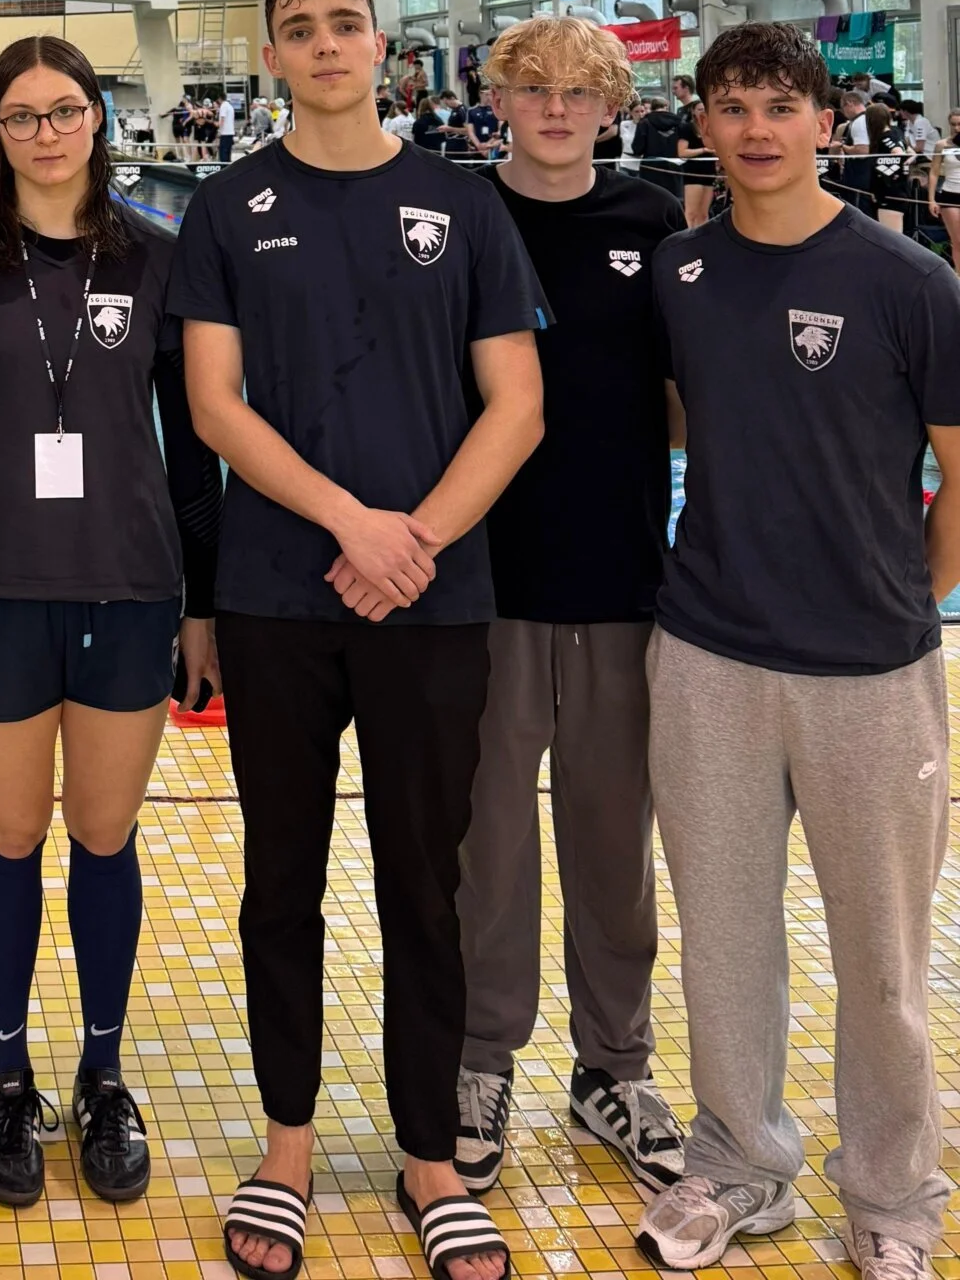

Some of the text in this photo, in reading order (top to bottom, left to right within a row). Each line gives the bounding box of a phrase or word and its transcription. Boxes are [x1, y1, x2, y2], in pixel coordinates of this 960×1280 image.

[627, 36, 668, 55] Dortmund
[877, 157, 901, 165] arena
[116, 166, 140, 175] arena
[196, 165, 221, 173] arena
[248, 187, 274, 208] arena
[254, 236, 298, 252] Jonas
[609, 249, 641, 261] arena
[678, 258, 703, 275] arena
